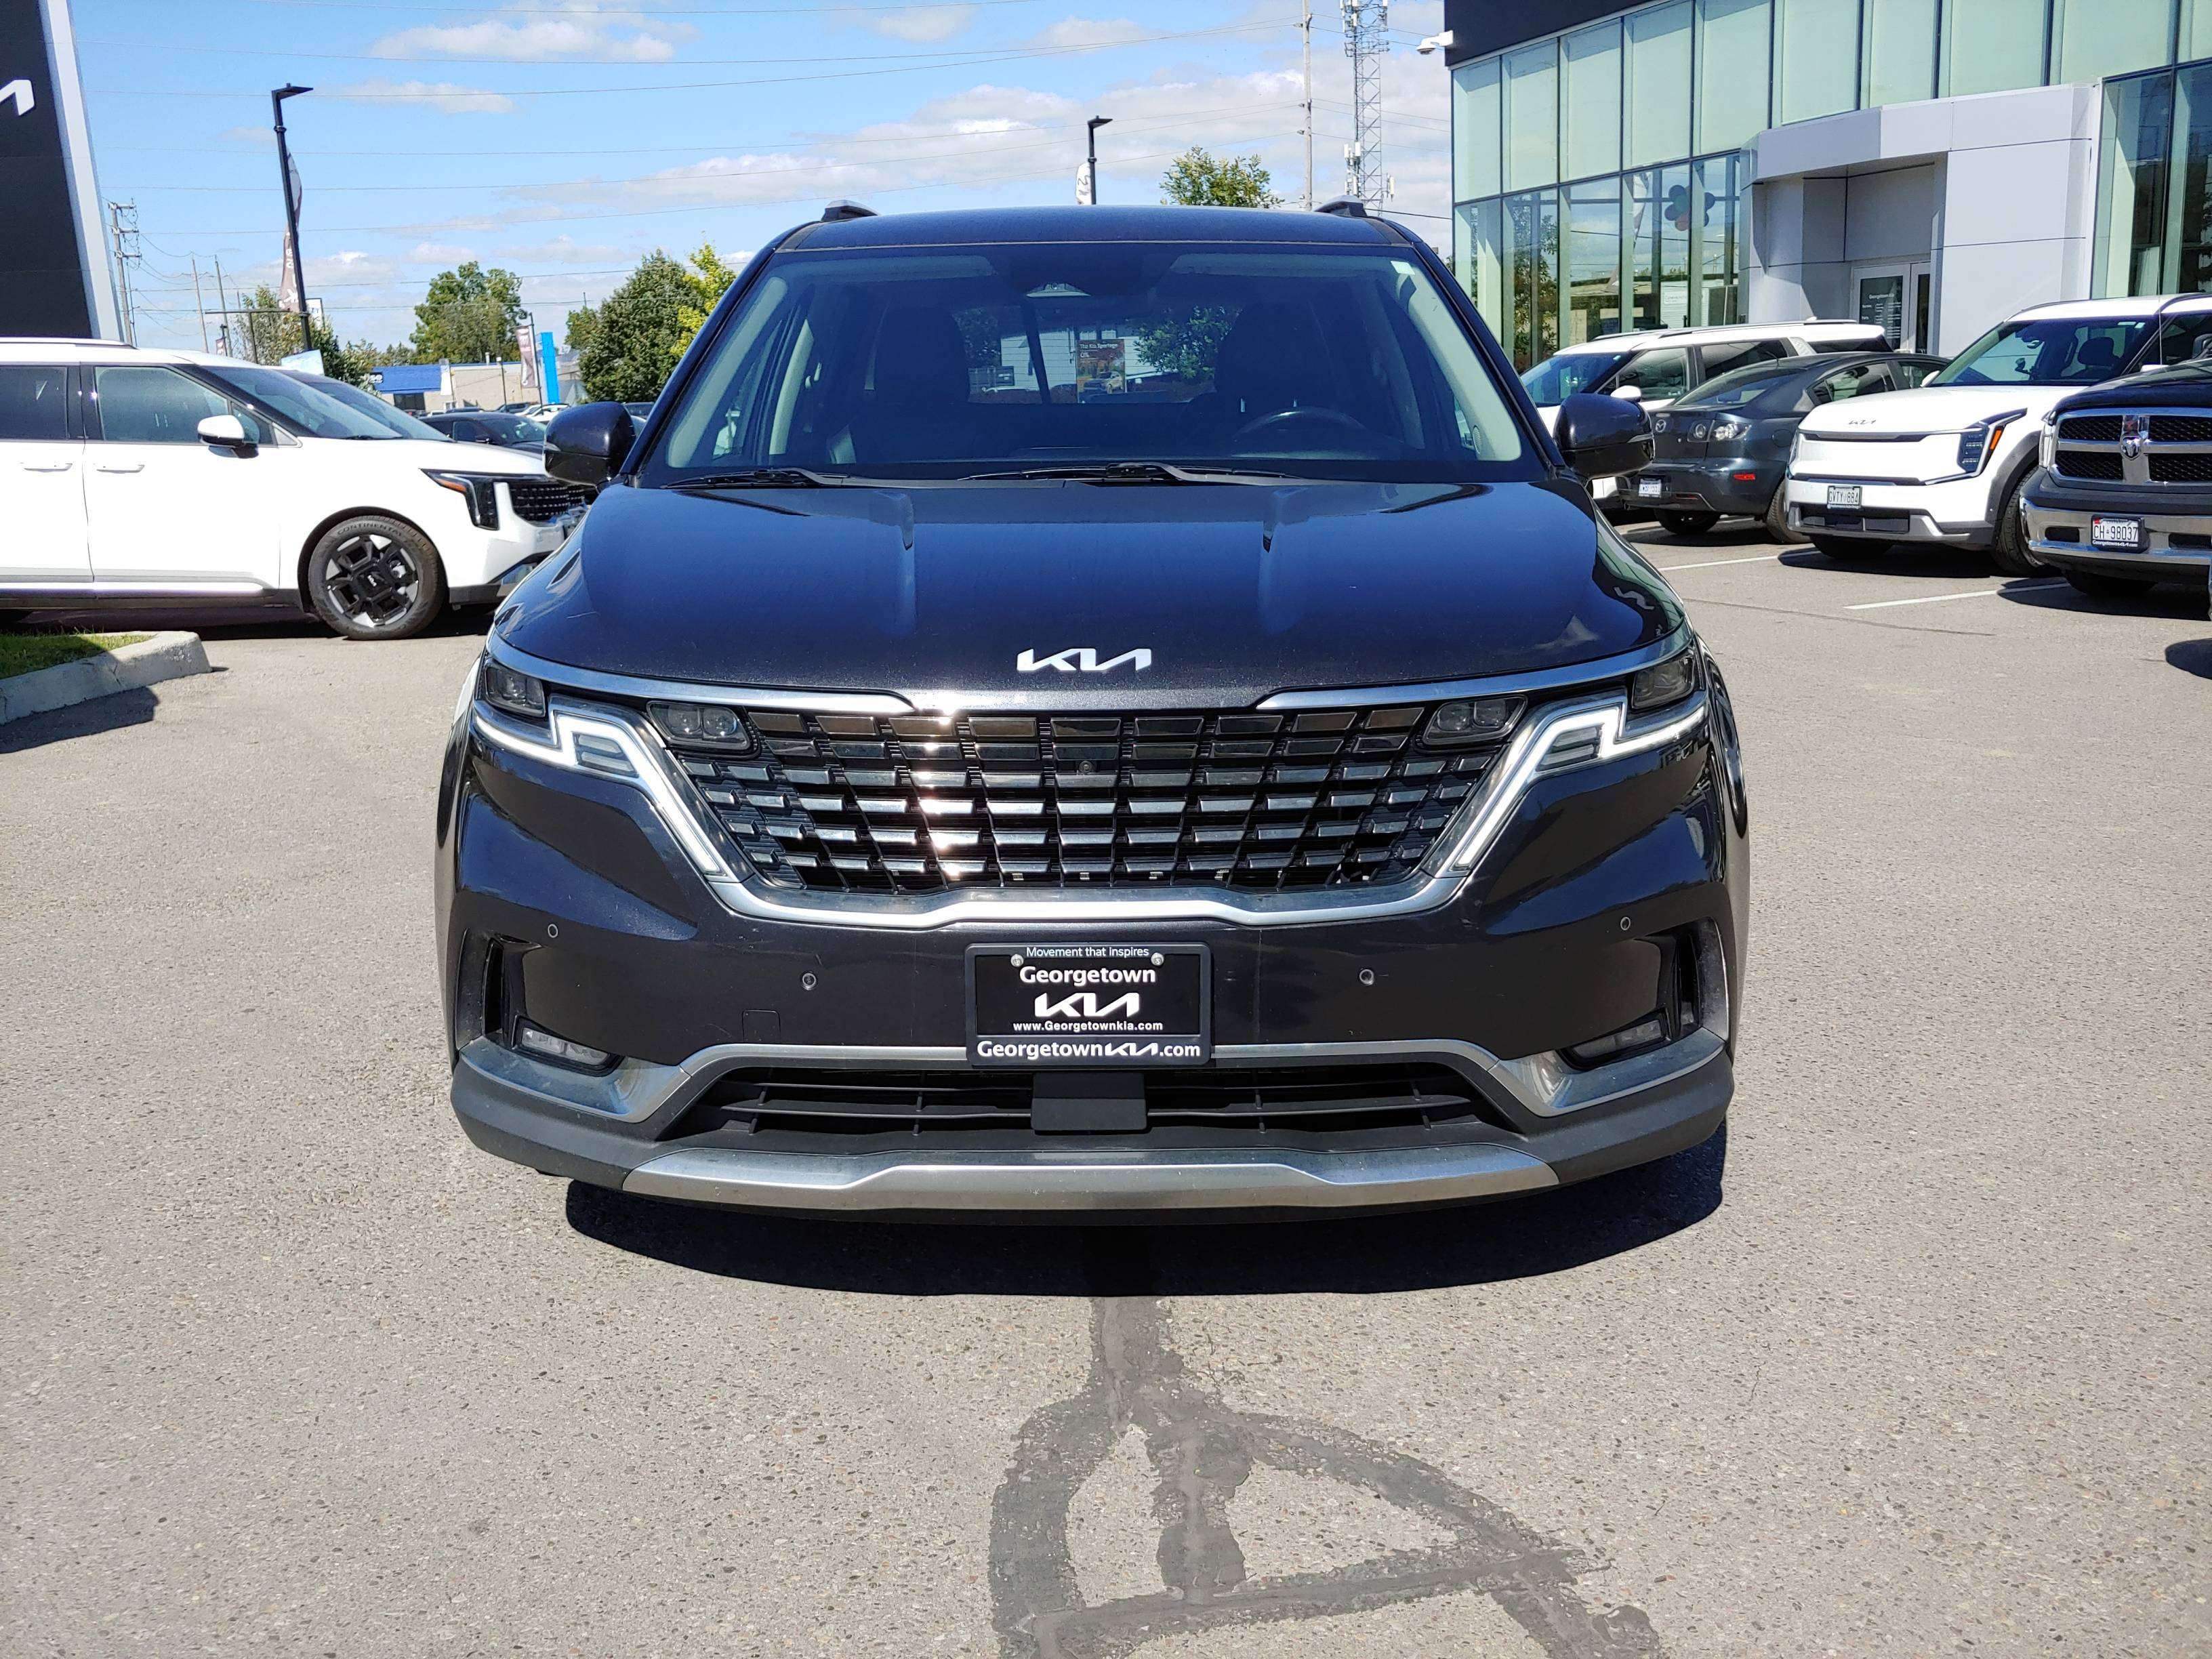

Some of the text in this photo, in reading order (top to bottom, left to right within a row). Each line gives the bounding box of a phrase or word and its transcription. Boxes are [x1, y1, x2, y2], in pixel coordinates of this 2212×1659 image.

[1017, 648, 1152, 671] KIA
[1026, 947, 1150, 959] Movement that inspires
[1019, 966, 1156, 987] Georgetown
[1034, 992, 1140, 1017] KIA
[1012, 1020, 1164, 1033] www.Georgetownkia.com
